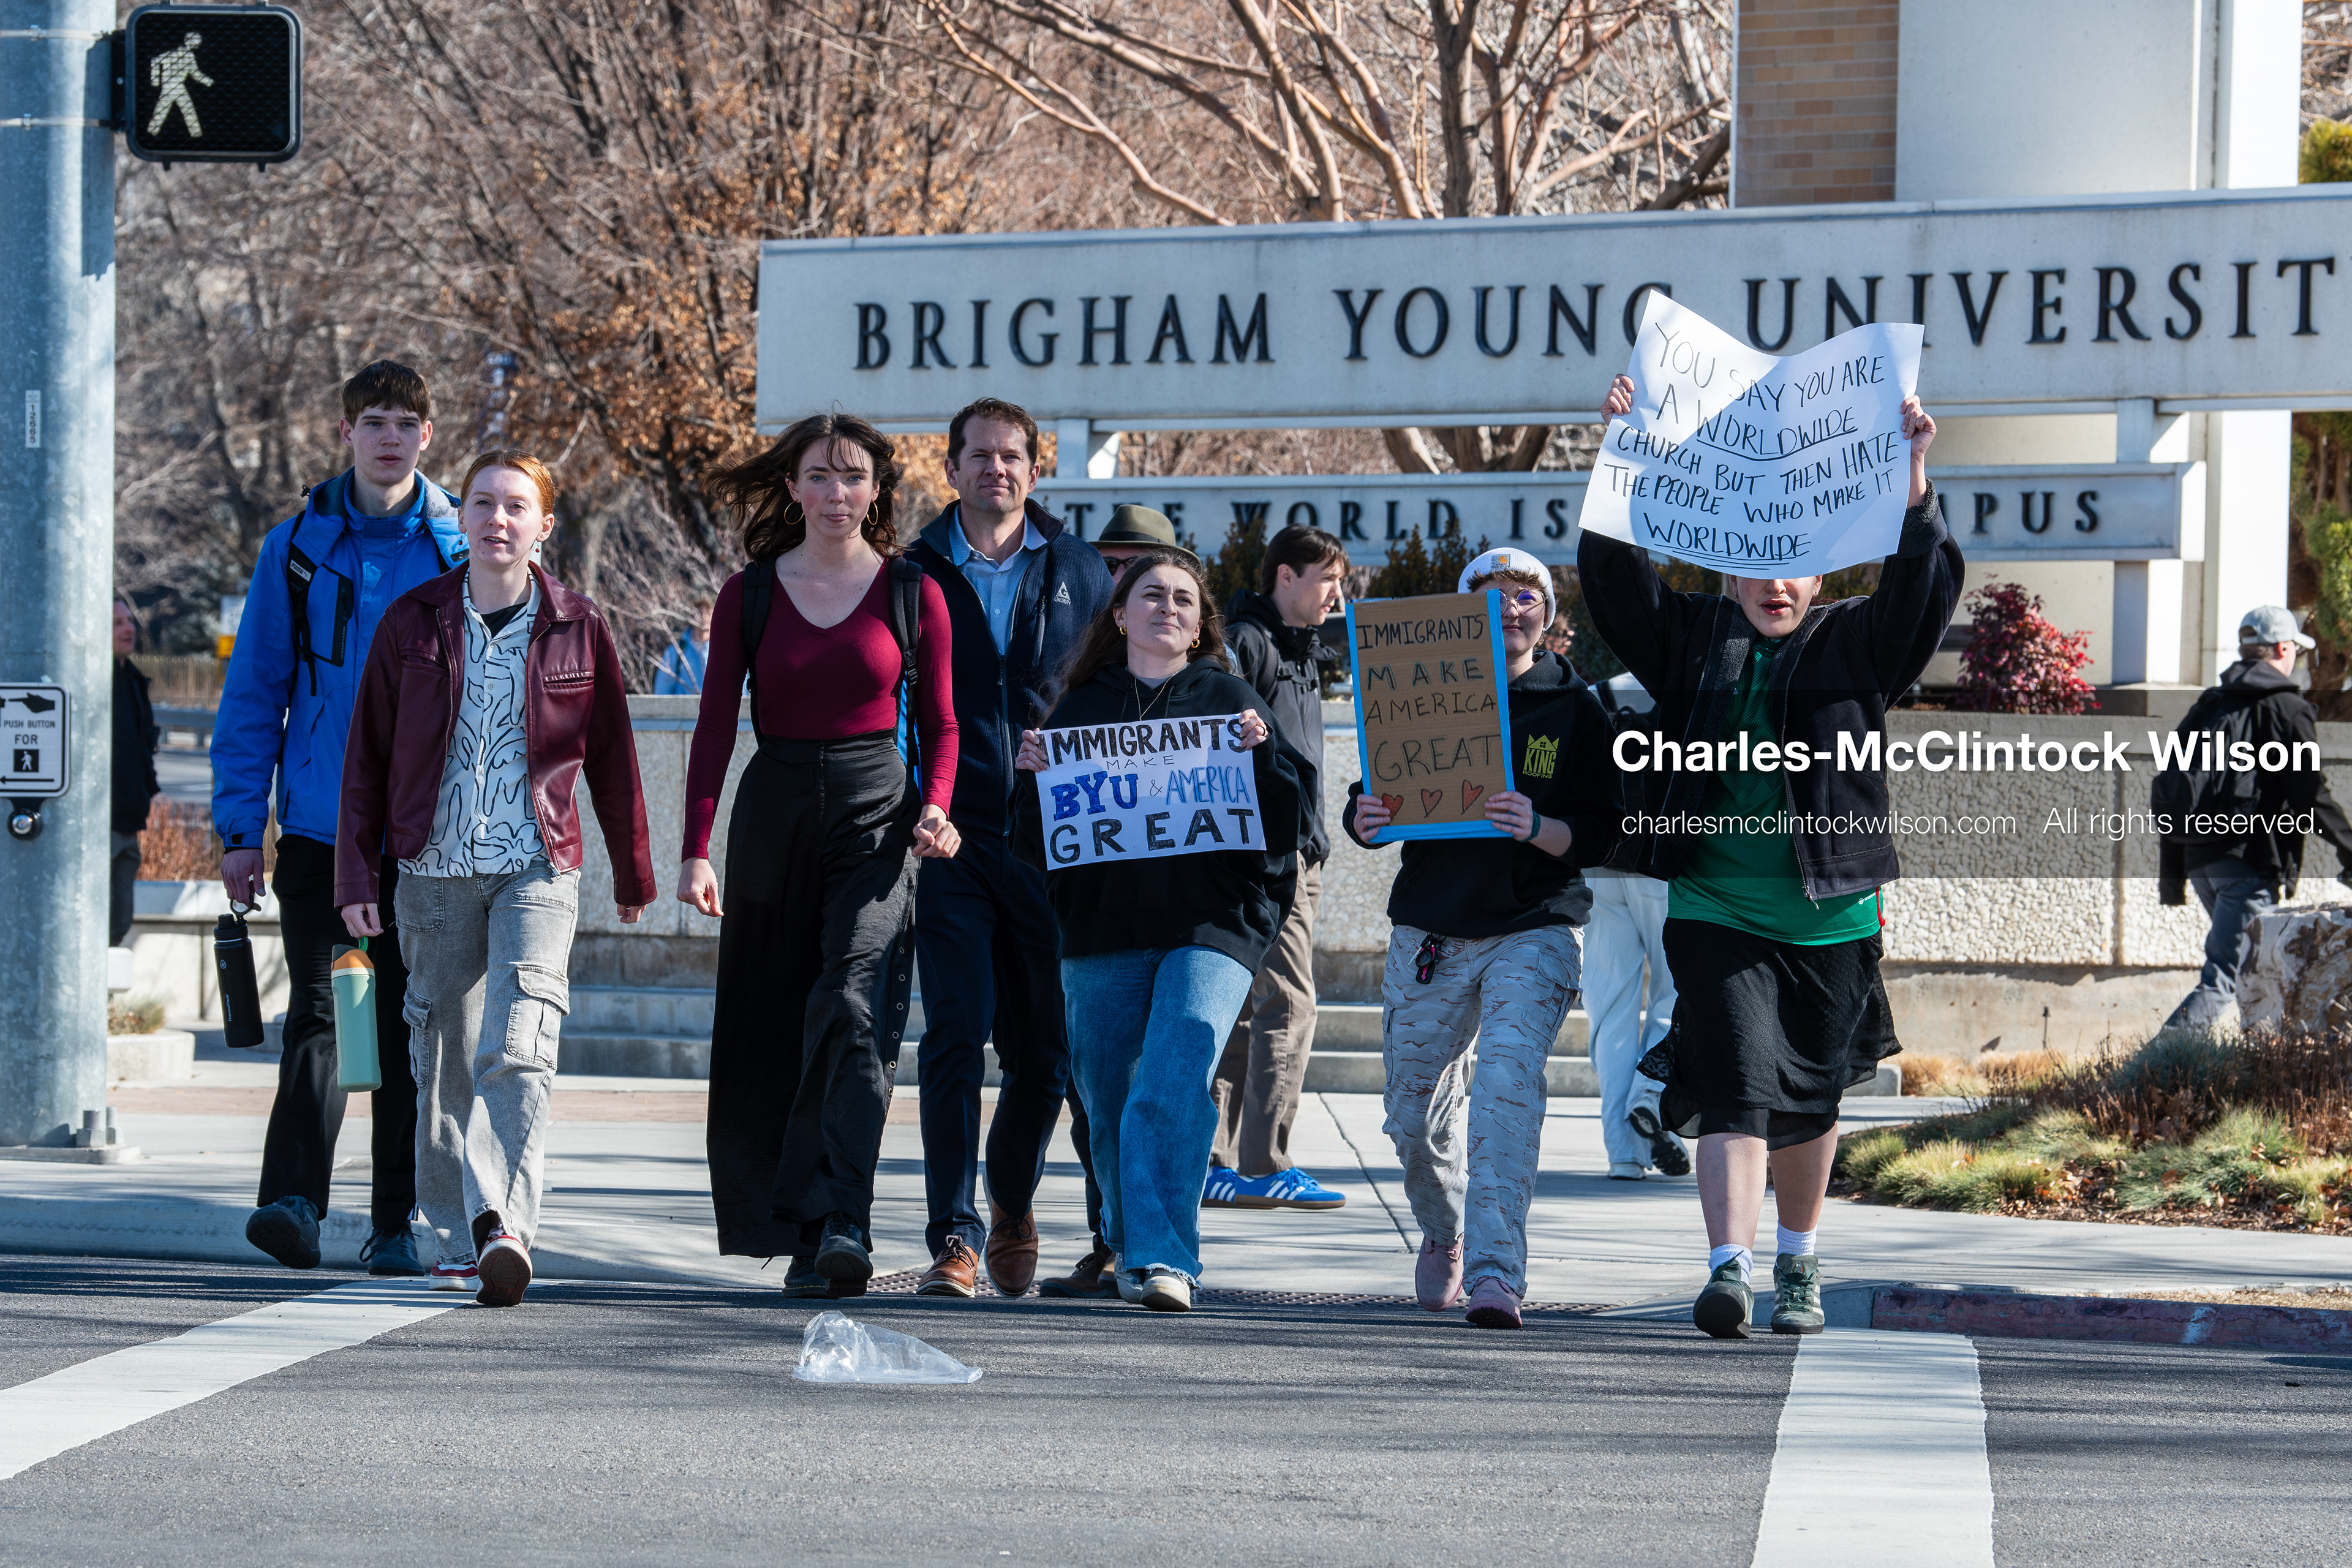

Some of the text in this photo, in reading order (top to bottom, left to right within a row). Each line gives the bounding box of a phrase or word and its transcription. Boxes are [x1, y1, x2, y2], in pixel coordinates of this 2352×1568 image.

[853, 293, 1275, 369] BRIGHAM
[1743, 257, 2352, 353] UNIVERSIT
[1655, 322, 1885, 412] YOU SAY YOU ARE
[1656, 383, 1856, 455] A WORLDWIDE
[1617, 426, 1899, 495] CHURCH BUT THEN HATE
[1604, 464, 1893, 524] THE PEOPLE WHO MAKE IT
[1938, 490, 2099, 534] PUS
[1065, 498, 1567, 541] TE WORLD IS
[1643, 513, 1812, 560] WORLDWIDE
[291, 562, 304, 574] PUMA
[1355, 613, 1487, 650] IMMIGRANTS
[1368, 658, 1483, 691] MAKE
[3, 719, 55, 728] PUSH BUTTON
[1364, 692, 1496, 727] AMERICA
[15, 734, 38, 745] FOR
[1036, 718, 1247, 767] IMMIGRANTS
[1374, 734, 1501, 782] GREAT
[1523, 747, 1557, 775] KING
[1106, 755, 1175, 770] MAKE
[1522, 770, 1553, 779] ROOFING
[1050, 766, 1251, 821] BYU & AMERICA
[1050, 808, 1254, 864] GREAT
